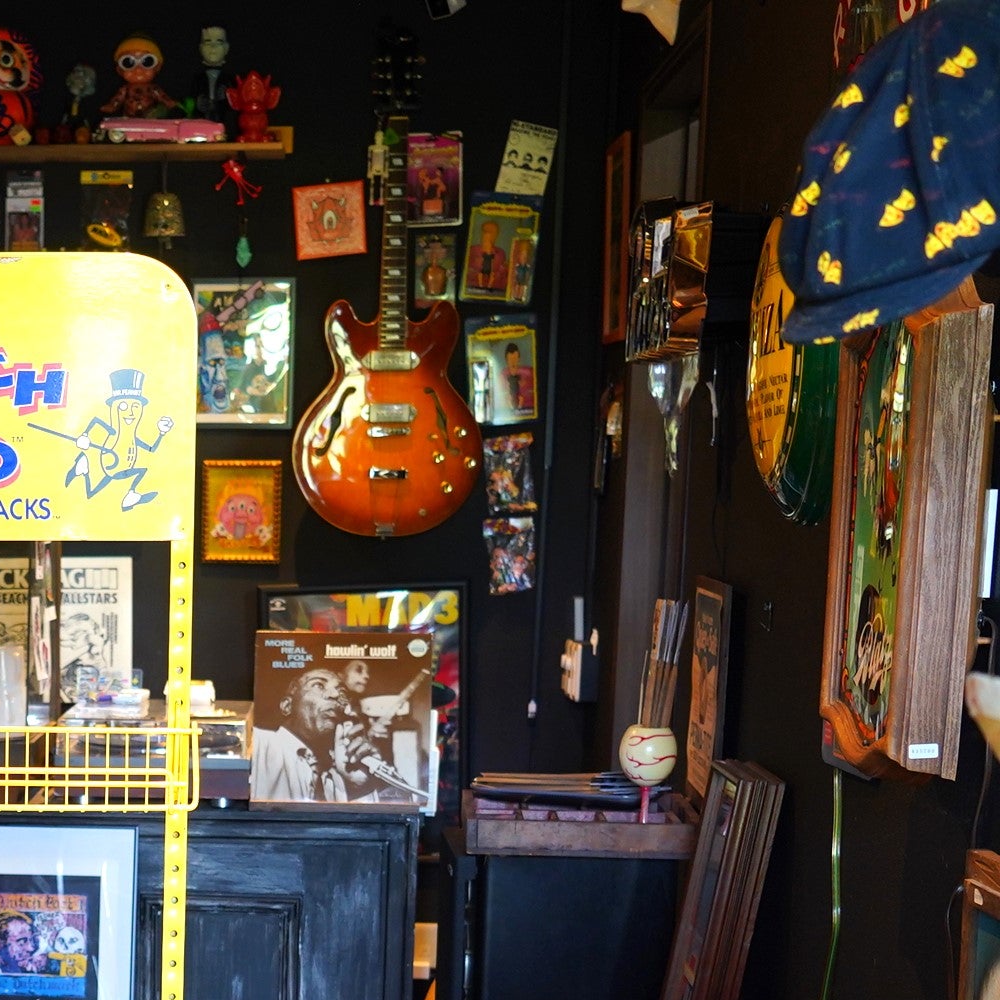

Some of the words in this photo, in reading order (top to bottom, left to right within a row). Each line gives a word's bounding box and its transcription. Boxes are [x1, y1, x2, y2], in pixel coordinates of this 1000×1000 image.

[264, 639, 296, 647] MORE
[280, 647, 308, 655] REAL
[369, 644, 397, 657] wolf
[286, 654, 314, 662] FOLK
[271, 661, 306, 669] BLUES
